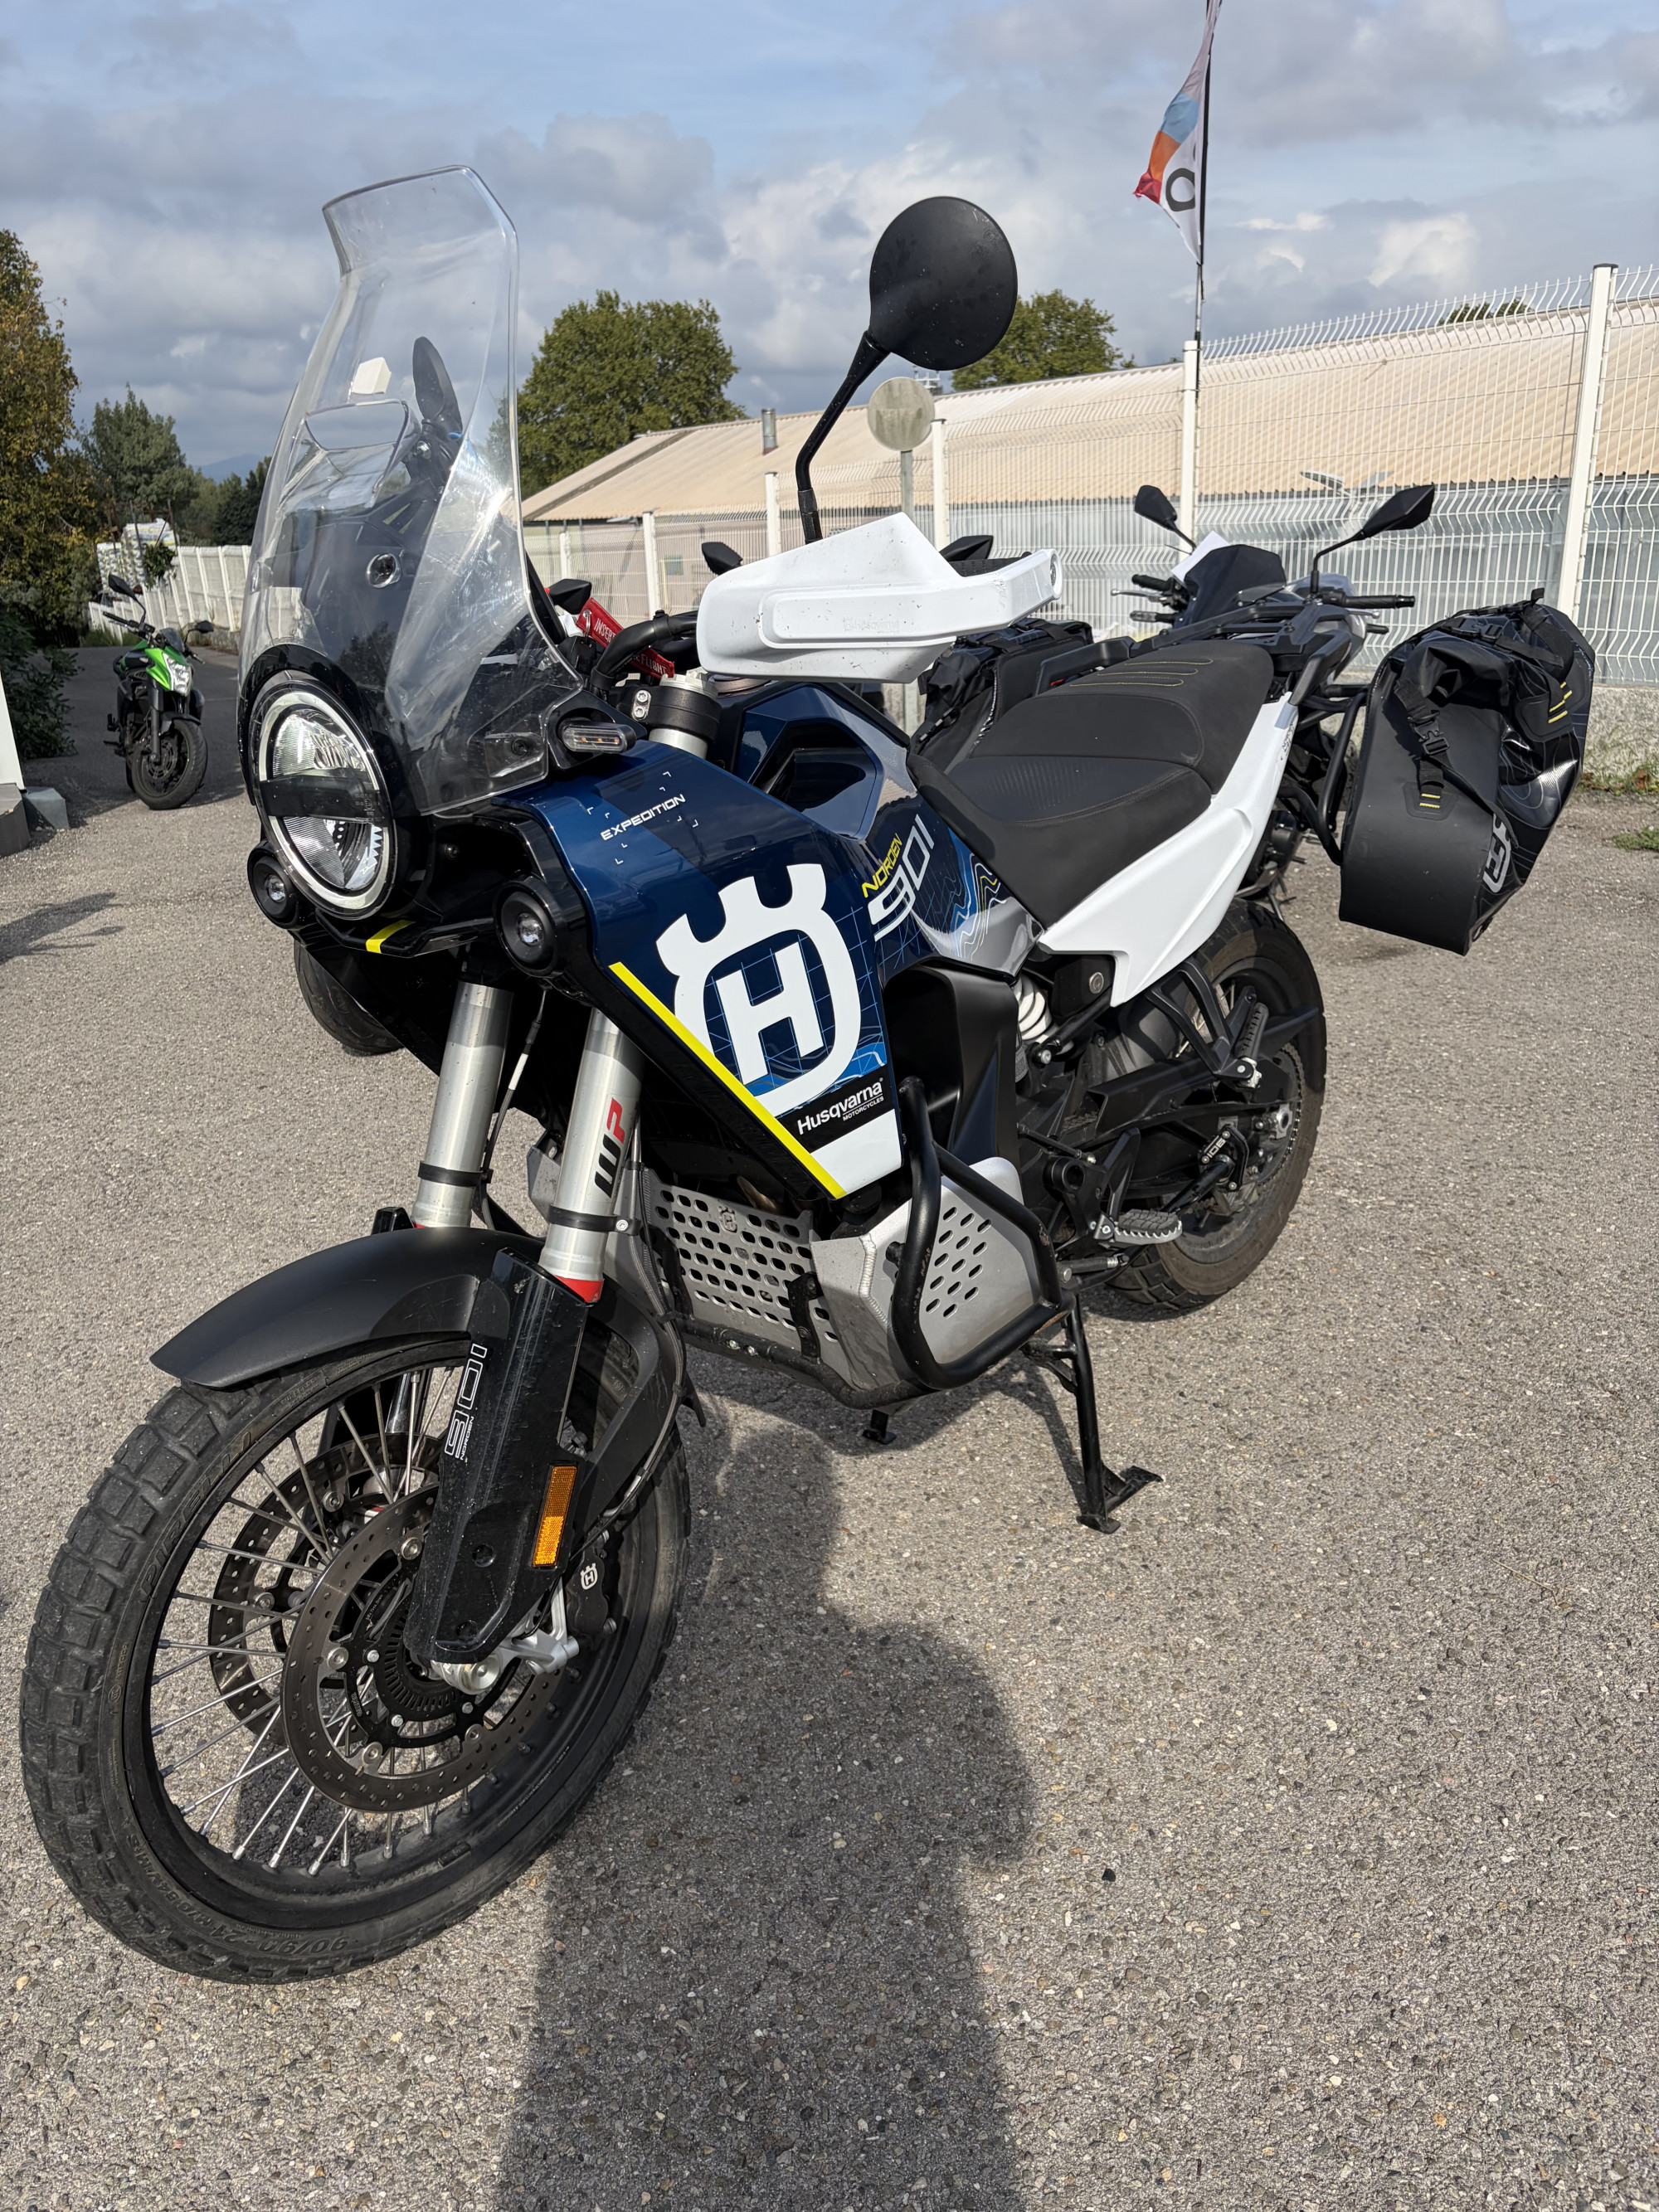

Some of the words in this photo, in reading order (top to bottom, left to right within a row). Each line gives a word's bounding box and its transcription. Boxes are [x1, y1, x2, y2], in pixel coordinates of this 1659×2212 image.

[601, 794, 686, 841] EXPEDITION
[862, 833, 902, 898] NORDEN
[868, 814, 935, 942] 901
[797, 1081, 883, 1135] Husqvarna
[843, 1096, 884, 1121] MOTORCYCLES
[595, 1097, 625, 1198] WP
[444, 1343, 488, 1458] 901
[460, 1416, 474, 1460] NORDEN
[140, 1432, 252, 1597] PIRELLI
